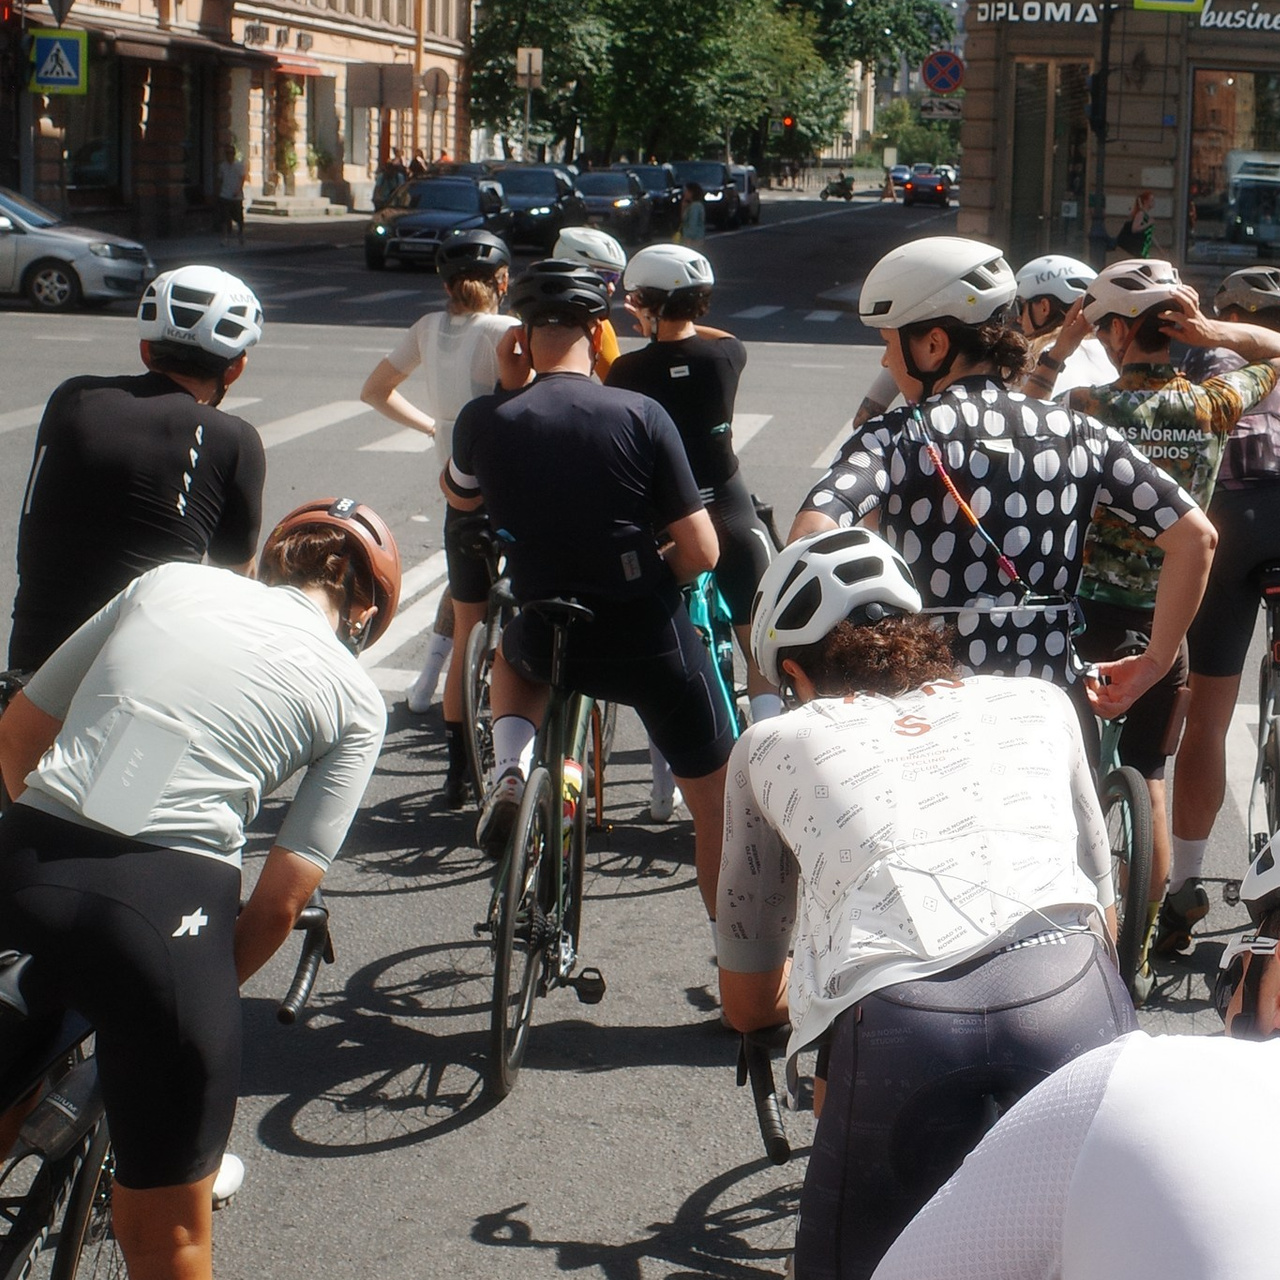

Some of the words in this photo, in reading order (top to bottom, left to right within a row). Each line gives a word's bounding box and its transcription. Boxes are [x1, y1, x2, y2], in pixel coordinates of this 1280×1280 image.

[1114, 426, 1138, 440] AS
[1140, 427, 1206, 442] NORMAL
[176, 424, 204, 517] MAAP
[894, 714, 932, 738] S
[937, 931, 954, 944] ROAD
[953, 925, 963, 934] TO
[938, 929, 968, 951] NOWHERE
